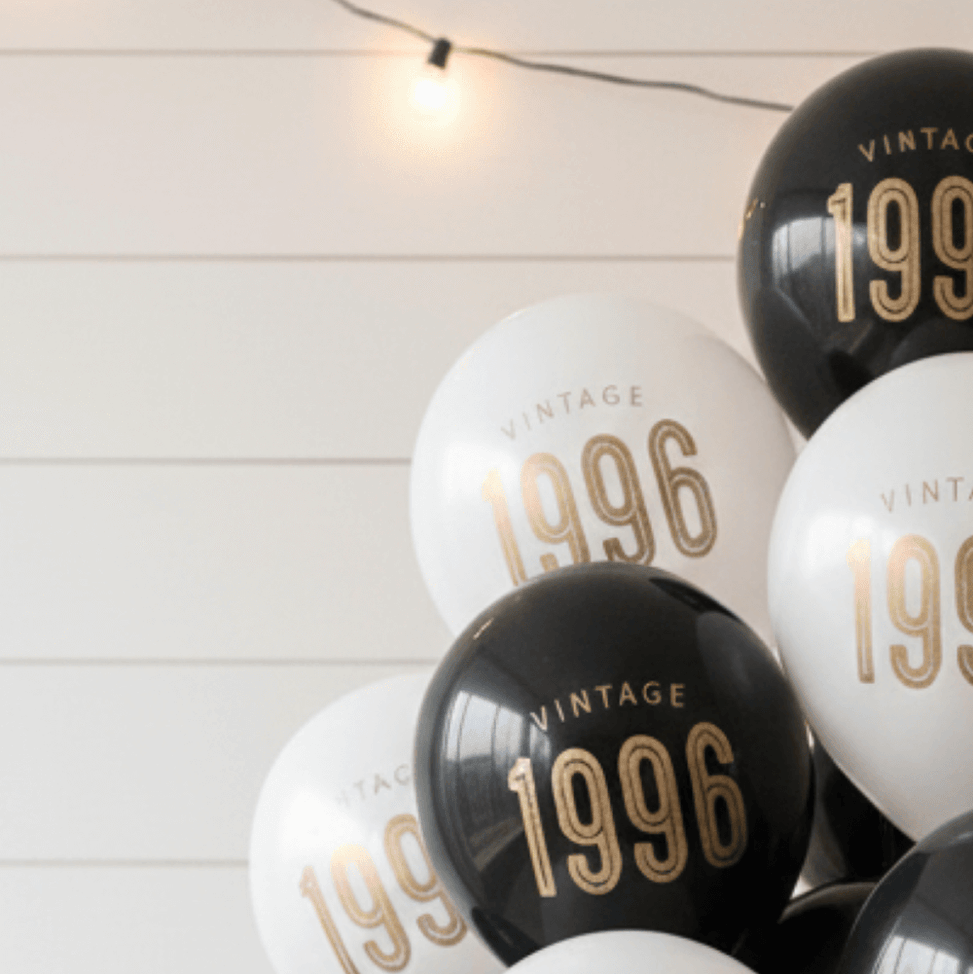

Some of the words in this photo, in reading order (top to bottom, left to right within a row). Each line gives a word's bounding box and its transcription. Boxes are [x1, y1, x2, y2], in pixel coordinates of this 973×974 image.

[500, 384, 644, 441] VINTAGE
[481, 418, 718, 587] 1996
[530, 681, 685, 731] VINTAGE
[508, 722, 748, 898] 1996
